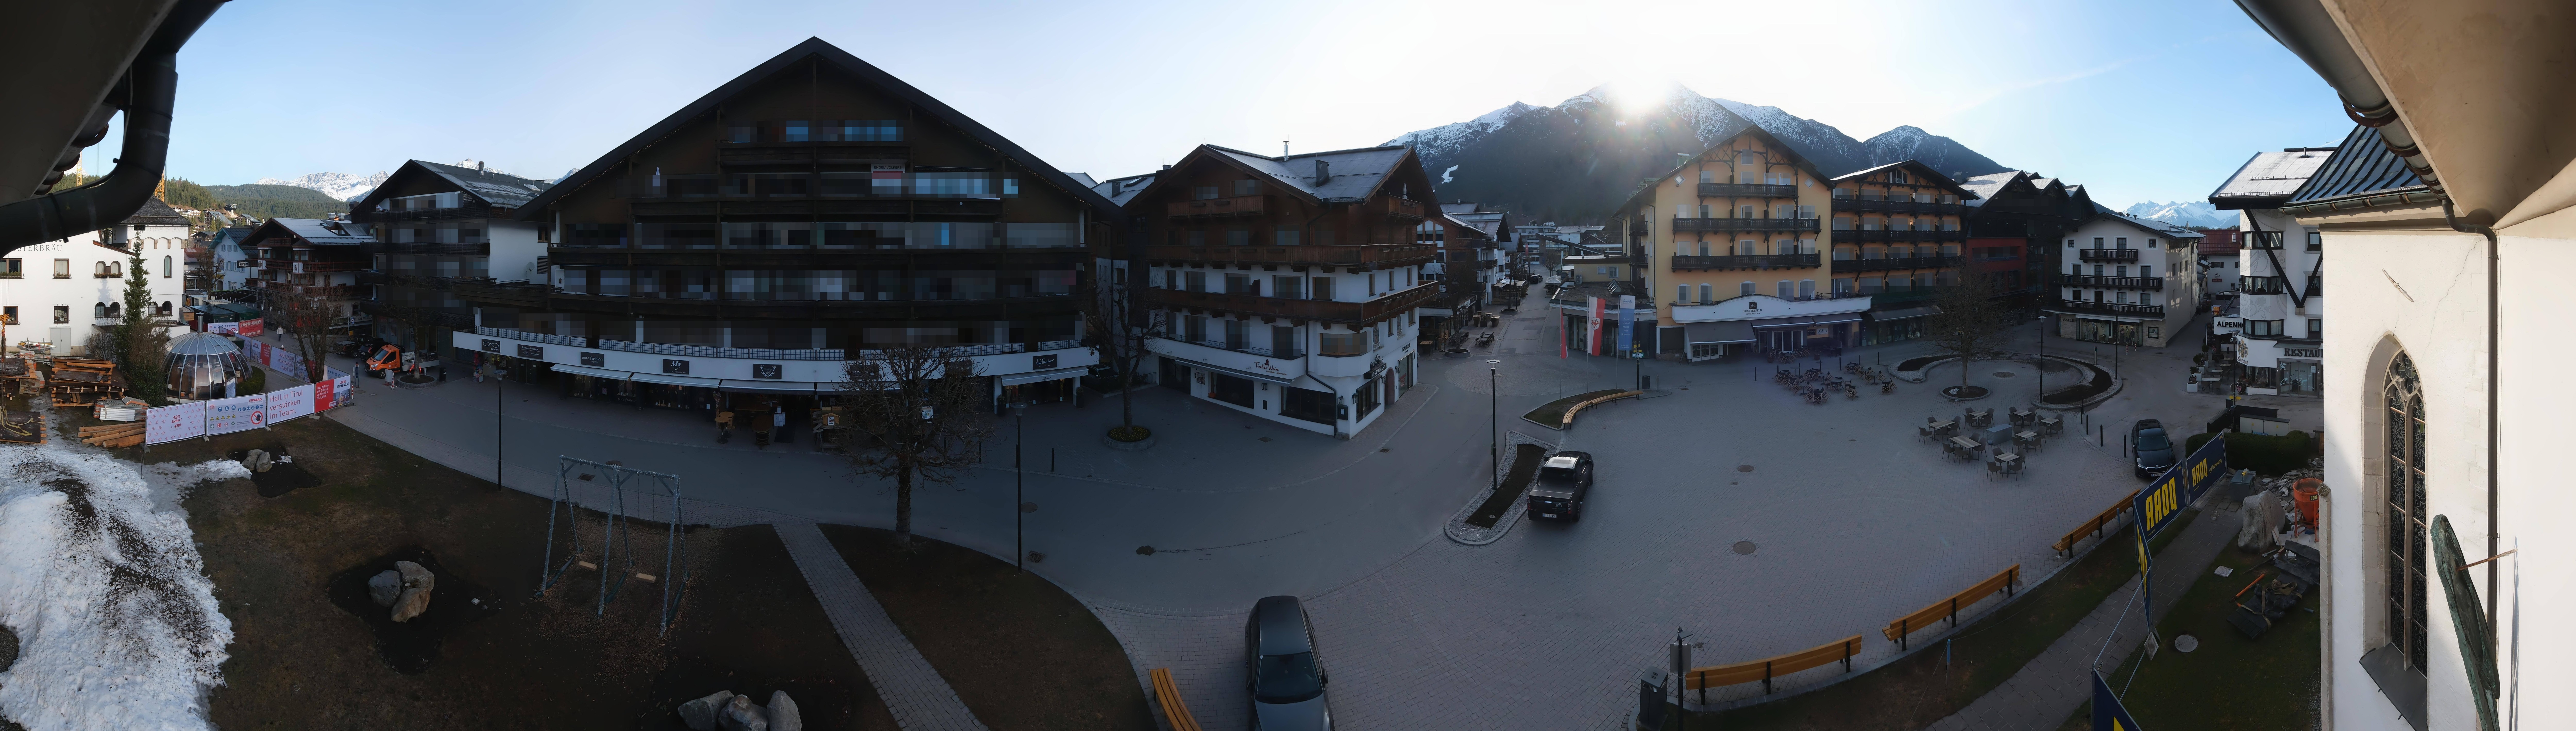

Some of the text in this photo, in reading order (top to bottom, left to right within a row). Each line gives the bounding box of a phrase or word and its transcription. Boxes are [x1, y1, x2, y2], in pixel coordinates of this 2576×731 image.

[1402, 343, 1411, 351] SAILER
[671, 361, 682, 370] My
[1371, 364, 1386, 377] RESTAURANT
[270, 394, 282, 402] Hall
[291, 389, 303, 398] Tirol
[270, 399, 302, 411] verstärken.
